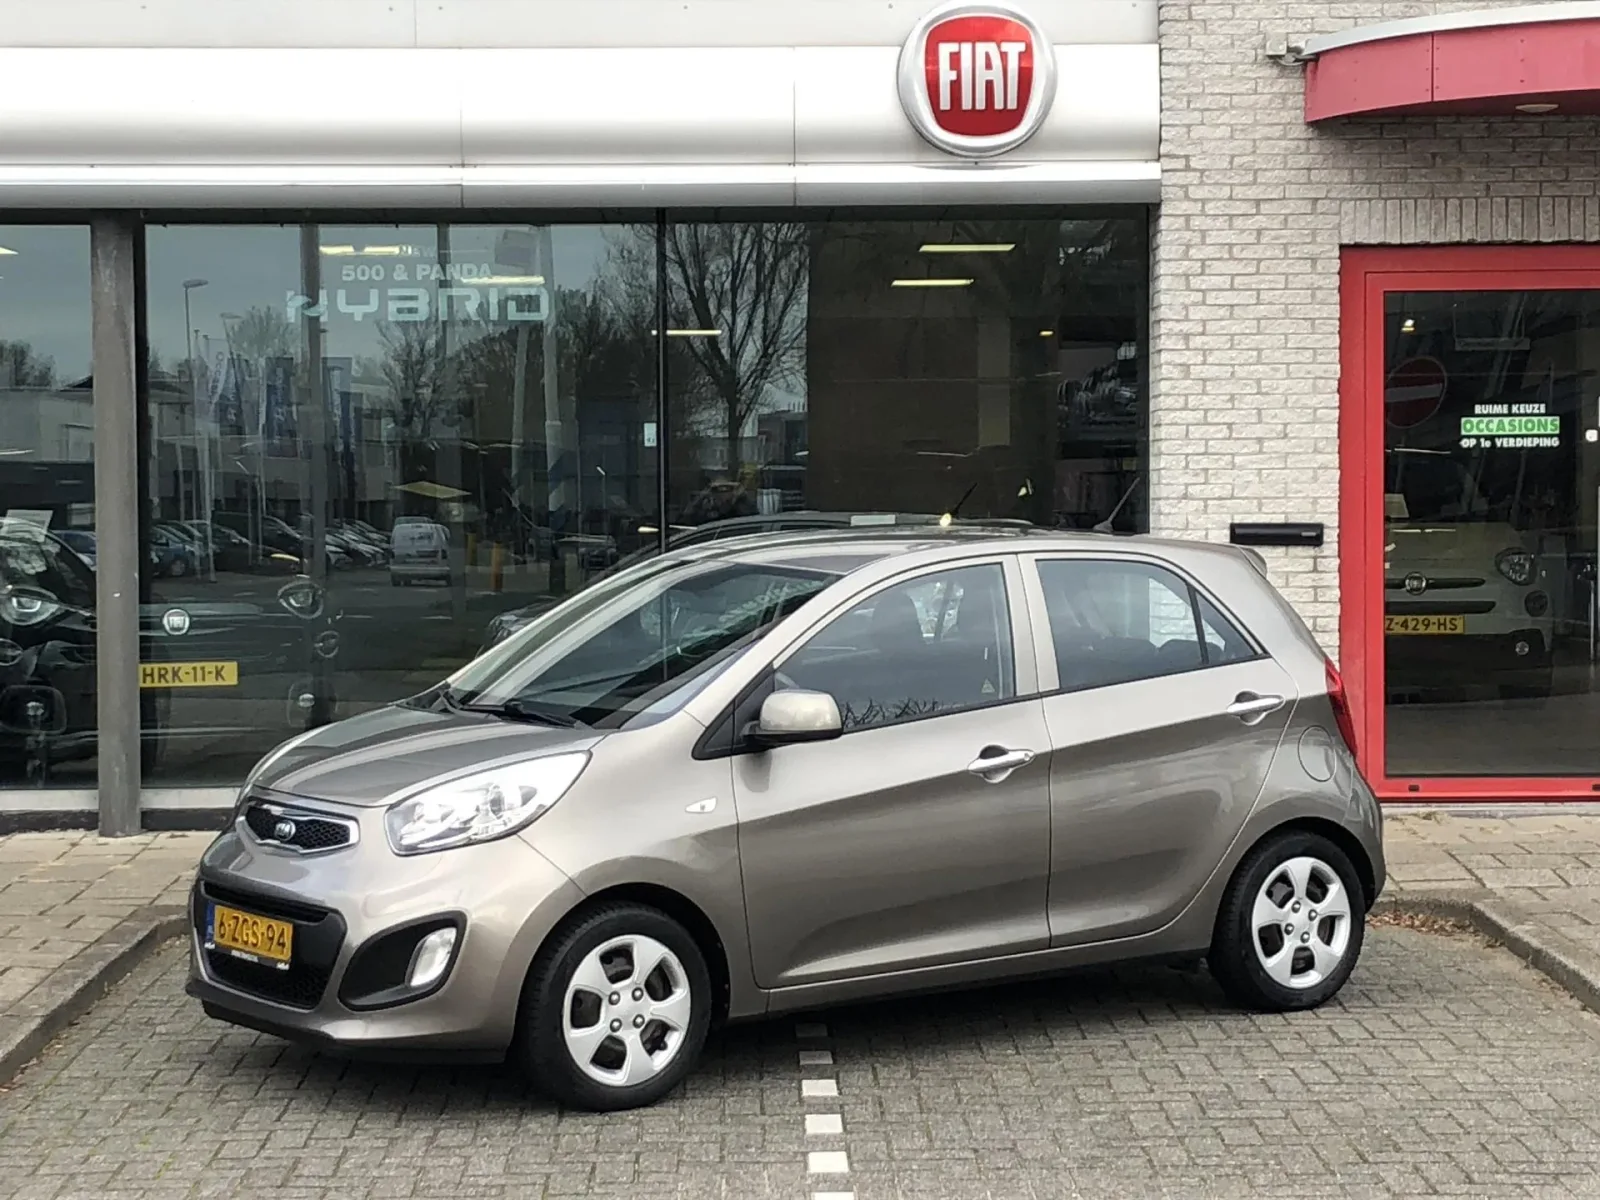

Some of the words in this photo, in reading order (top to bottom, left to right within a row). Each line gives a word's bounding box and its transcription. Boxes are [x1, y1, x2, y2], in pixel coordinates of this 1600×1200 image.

[938, 42, 1026, 110] FIAT
[341, 264, 385, 281] 500
[393, 264, 409, 281] &
[416, 263, 492, 280] PANDA
[286, 287, 549, 323] HYBRID
[1474, 404, 1509, 414] RUIME
[1511, 403, 1546, 413] KEUZE
[1462, 418, 1559, 433] OCCASIONS
[1461, 438, 1477, 448] OP
[1495, 437, 1560, 448] VERDIEPING
[142, 665, 227, 684] HRK-11-K
[217, 910, 288, 957] 6-ZGS-94
